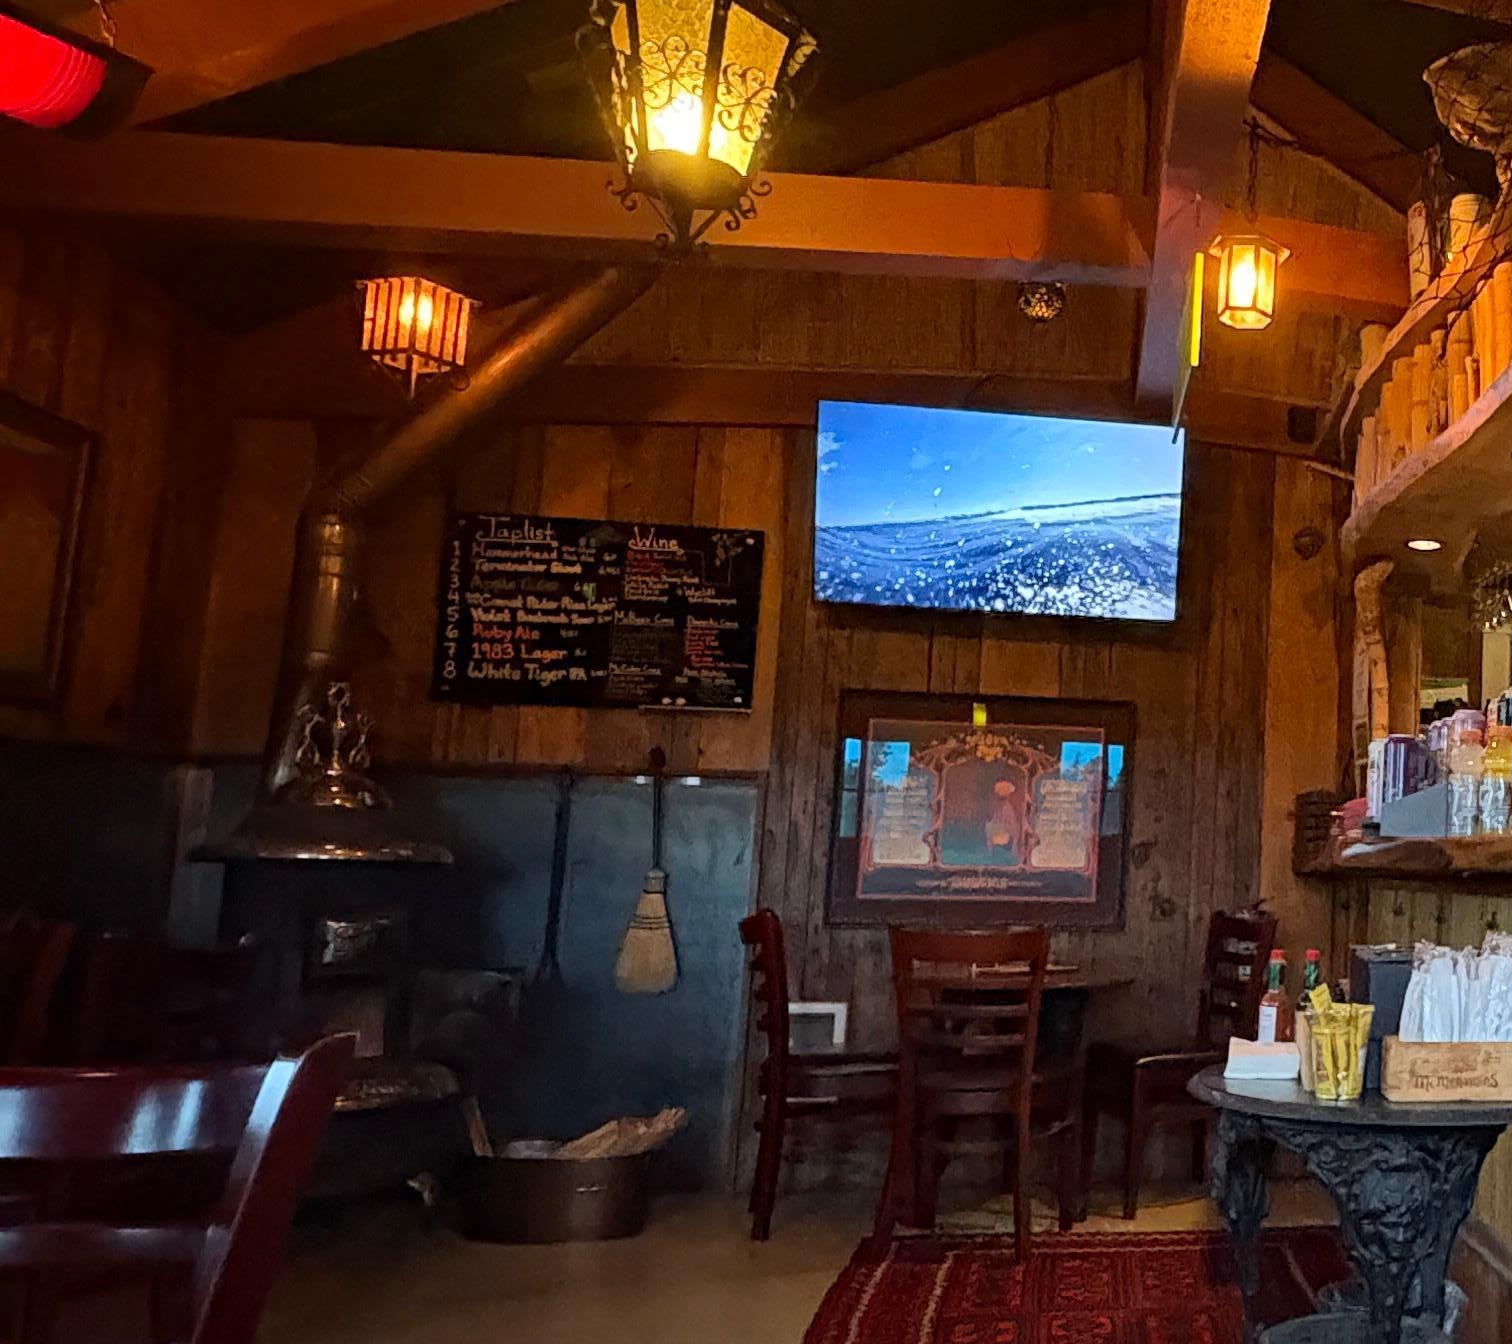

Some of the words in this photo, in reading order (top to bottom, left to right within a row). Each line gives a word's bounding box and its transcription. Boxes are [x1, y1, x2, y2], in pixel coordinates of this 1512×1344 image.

[478, 515, 554, 544] Taplist
[450, 559, 461, 573] 2
[450, 574, 461, 589] 3
[447, 591, 460, 604] 4
[447, 606, 459, 622] 5
[446, 623, 459, 639] 6
[442, 660, 457, 679] 8
